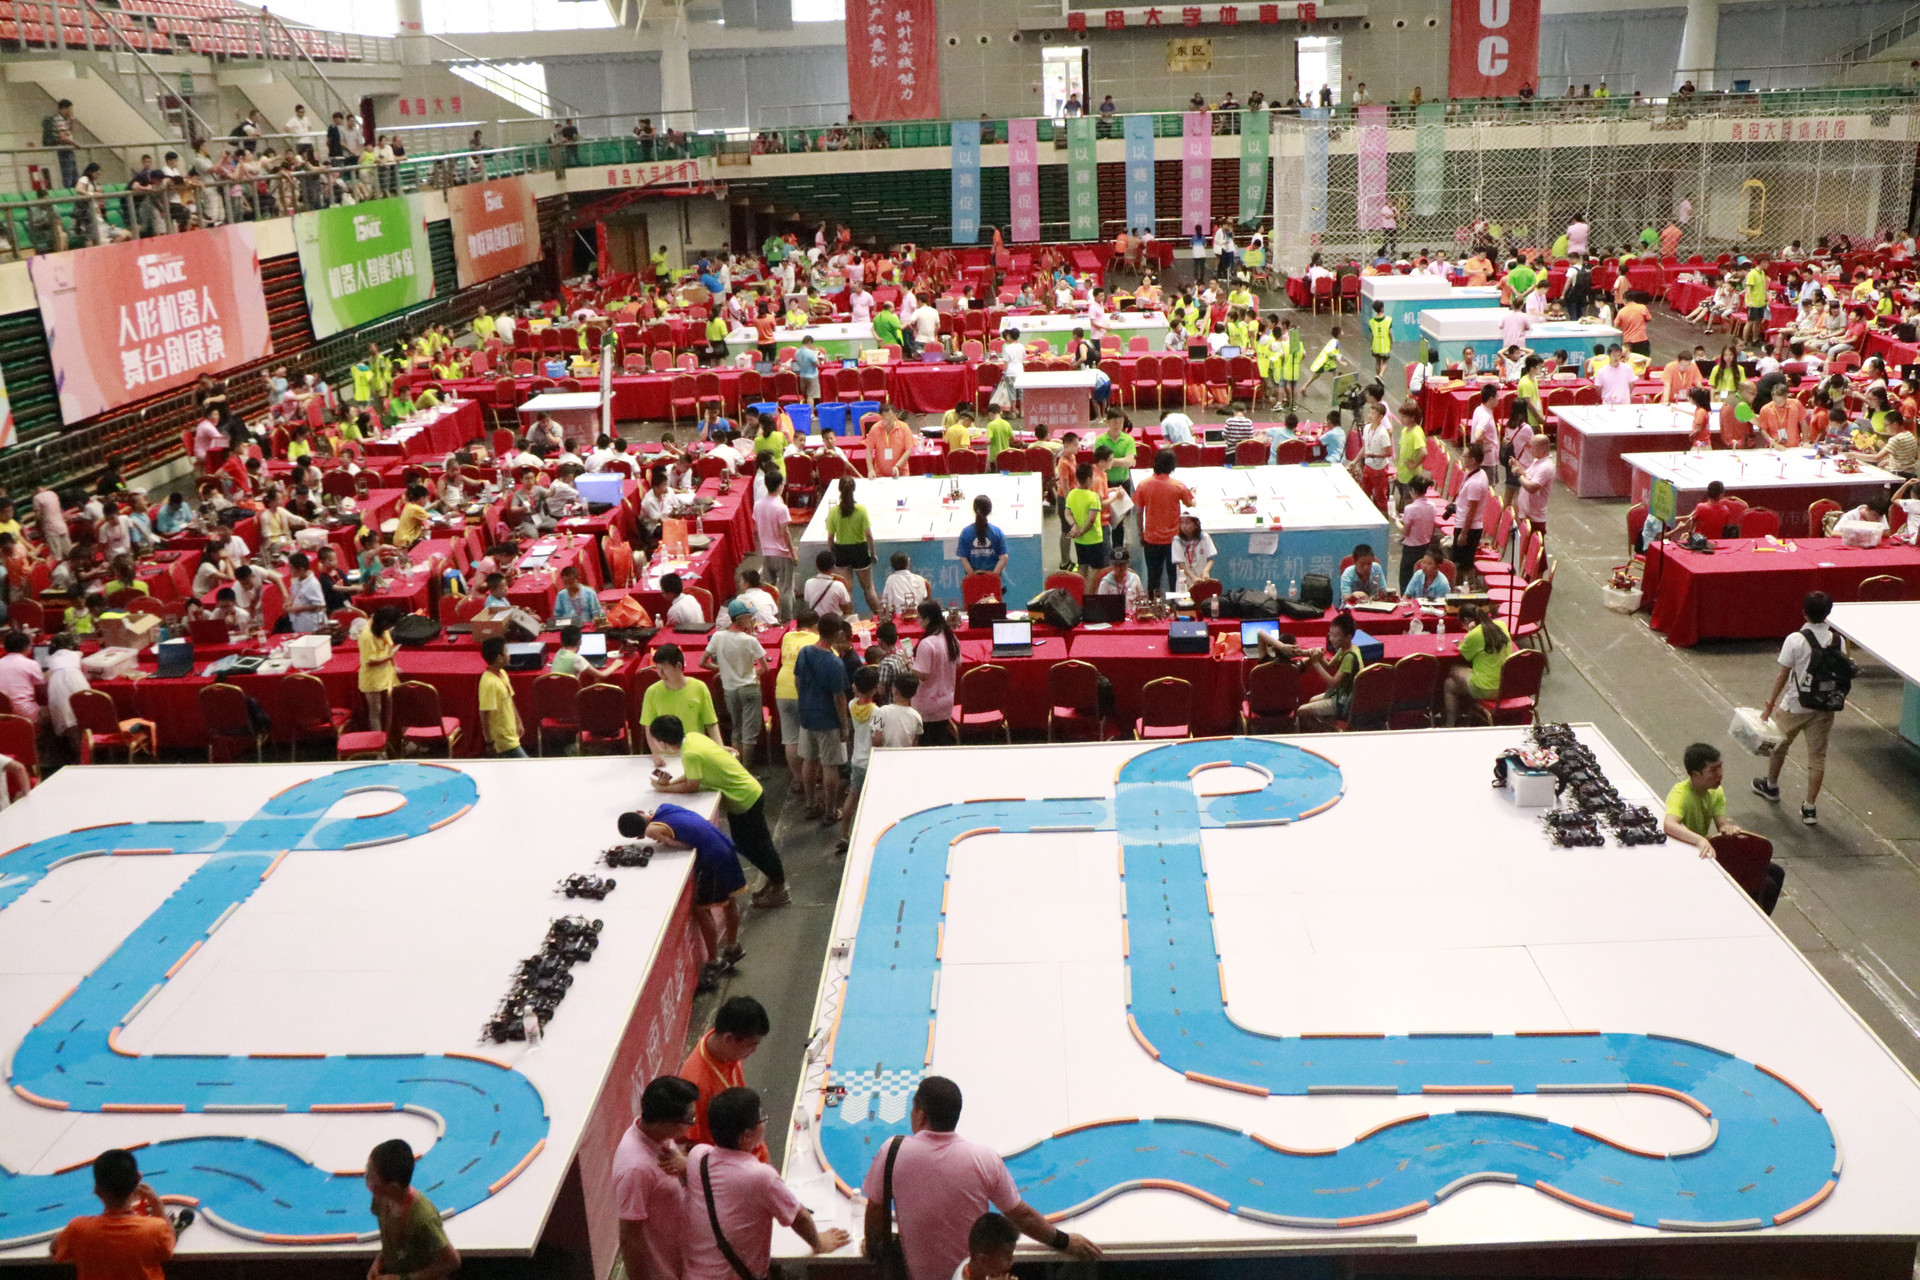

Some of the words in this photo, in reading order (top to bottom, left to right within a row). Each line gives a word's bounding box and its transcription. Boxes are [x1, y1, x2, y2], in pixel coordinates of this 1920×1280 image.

[1067, 3, 1317, 31] 青岛大学体育馆
[399, 96, 461, 116] 青岛大学
[328, 248, 416, 299] 机器人智能环保
[118, 286, 218, 346] 人形机器人
[120, 325, 226, 390] 舞台剧展演
